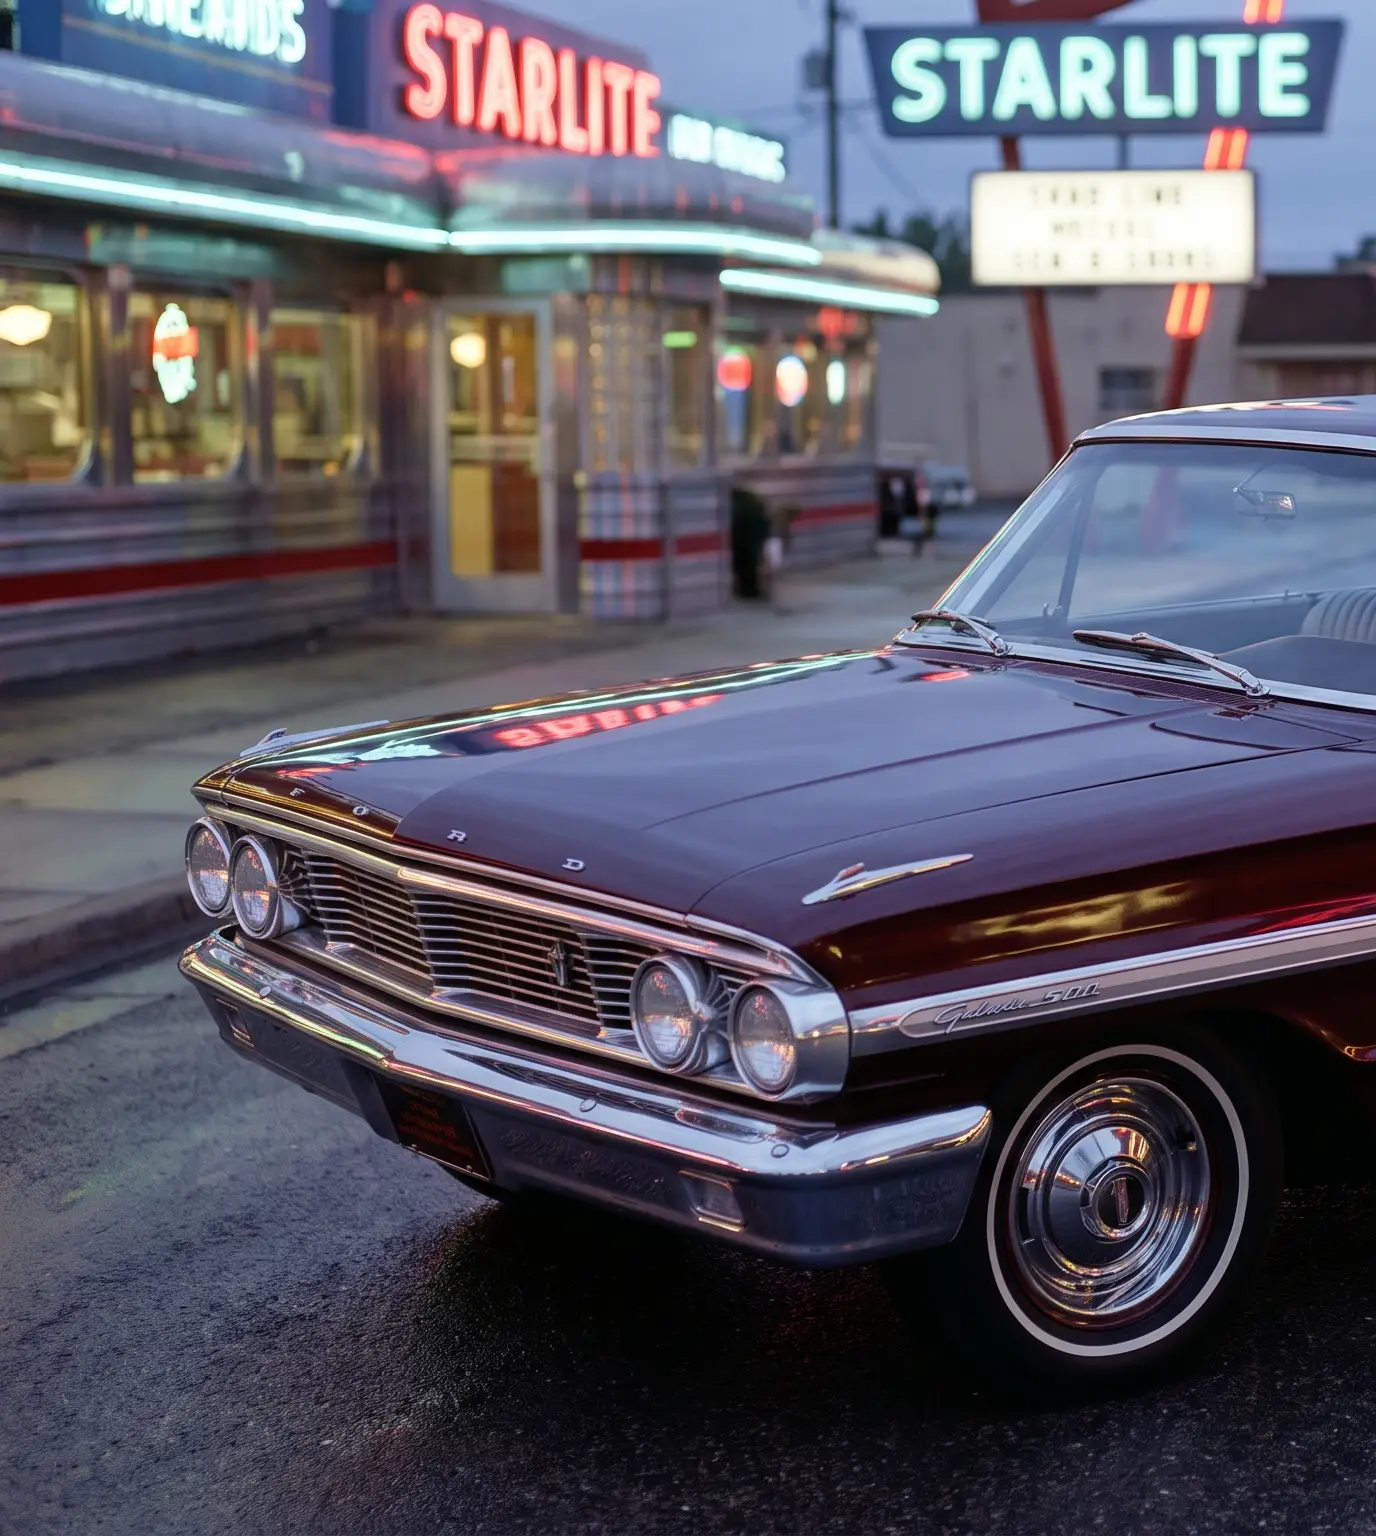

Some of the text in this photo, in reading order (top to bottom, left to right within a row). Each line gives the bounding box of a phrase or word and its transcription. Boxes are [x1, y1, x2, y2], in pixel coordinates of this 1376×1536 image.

[403, 2, 662, 158] STARLITE
[890, 33, 1311, 123] STARLITE
[289, 787, 586, 873] FORD
